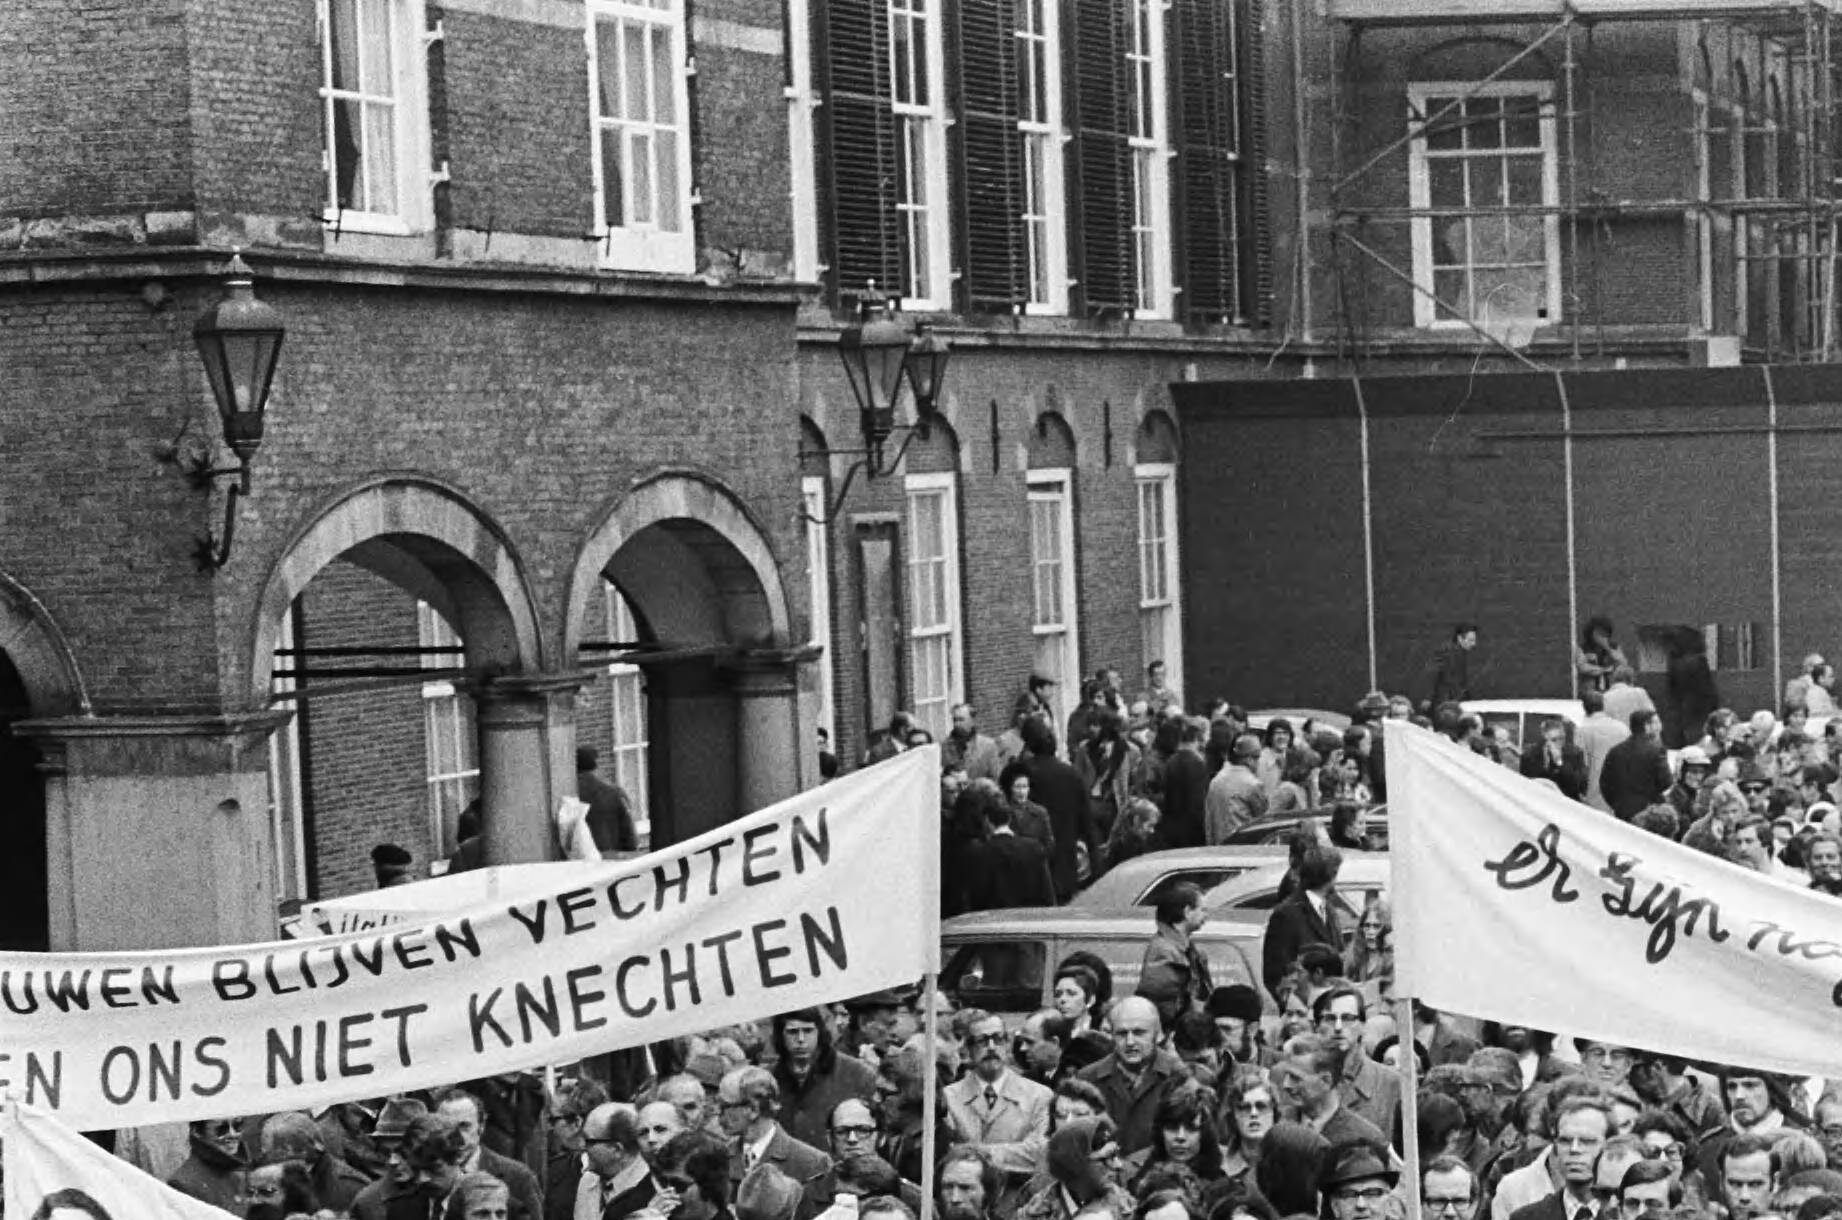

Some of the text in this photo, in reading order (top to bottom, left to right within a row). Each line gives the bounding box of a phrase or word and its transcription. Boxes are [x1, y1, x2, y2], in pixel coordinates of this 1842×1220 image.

[211, 919, 482, 1002] BLIJVEN
[508, 806, 831, 945] VECHTEN
[1484, 822, 1581, 905] er
[1599, 850, 1730, 965] zijn
[100, 1035, 231, 1106] ONS
[265, 1002, 430, 1089] NIET
[470, 905, 849, 1053] KNECHTEN
